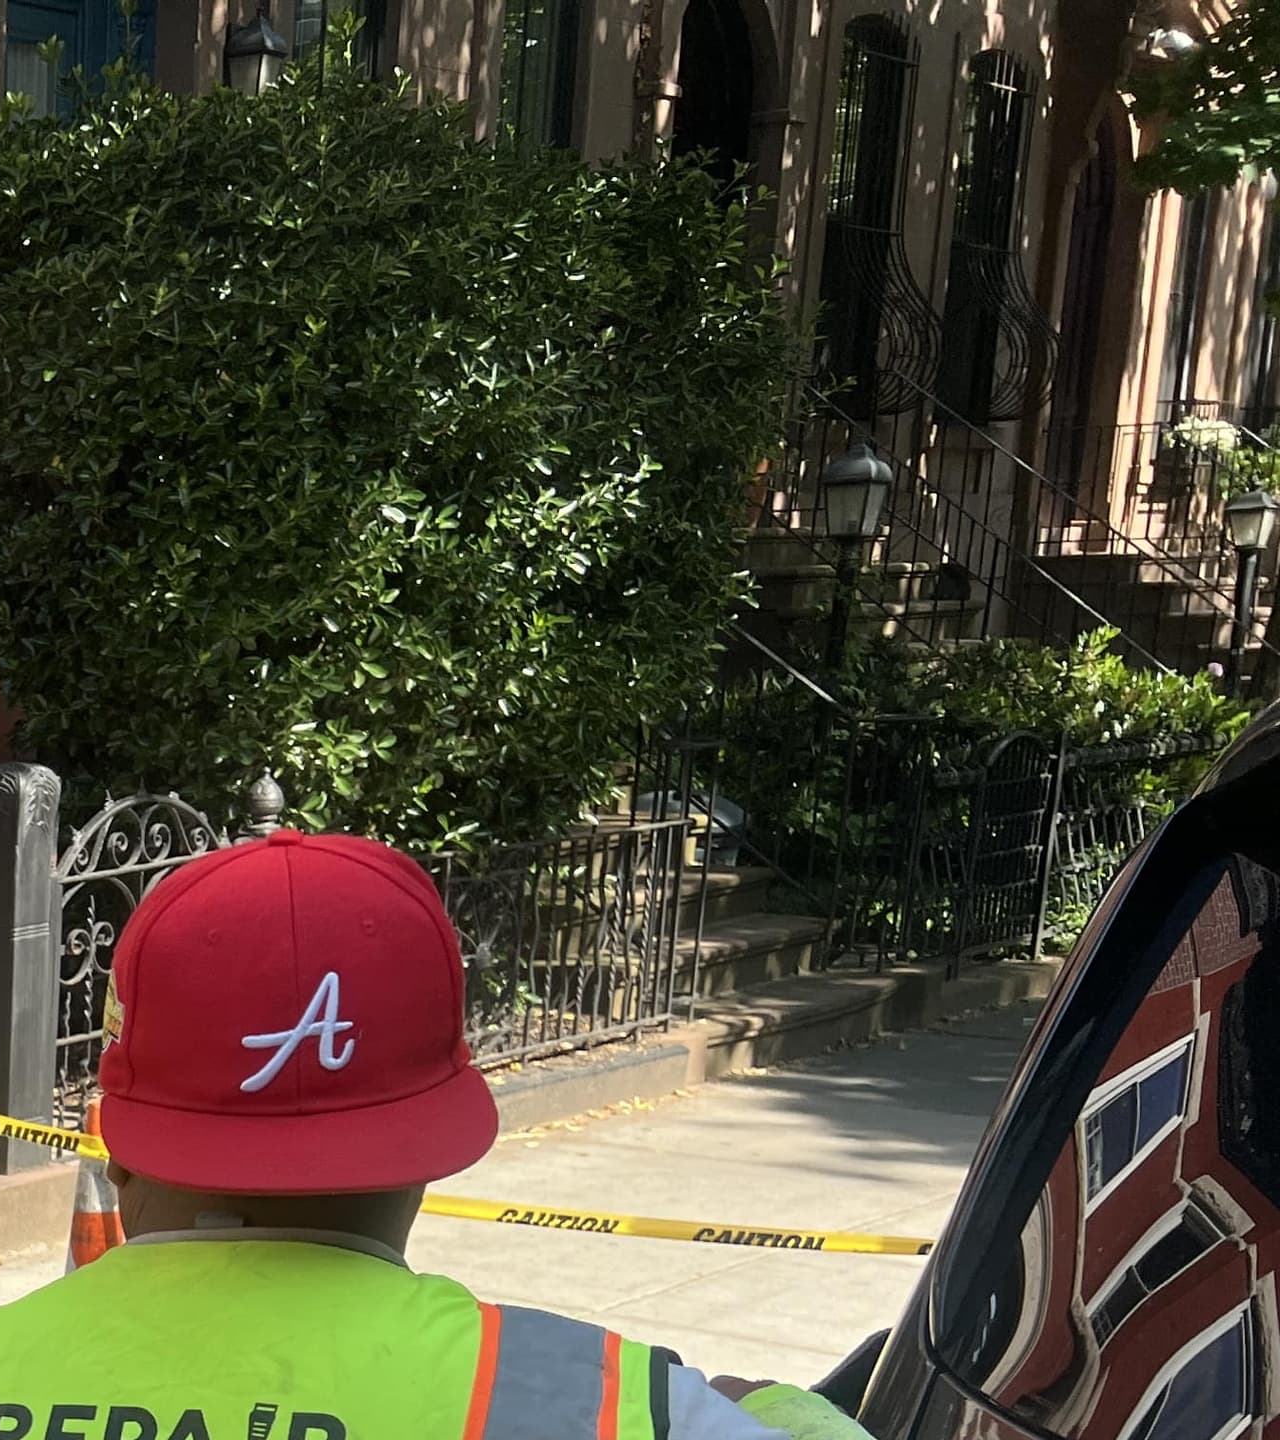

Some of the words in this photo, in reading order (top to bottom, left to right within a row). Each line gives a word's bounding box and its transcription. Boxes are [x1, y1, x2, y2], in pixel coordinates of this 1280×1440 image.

[240, 971, 355, 1092] A
[496, 1208, 621, 1234] CAUTION
[692, 1227, 826, 1251] CAUTION
